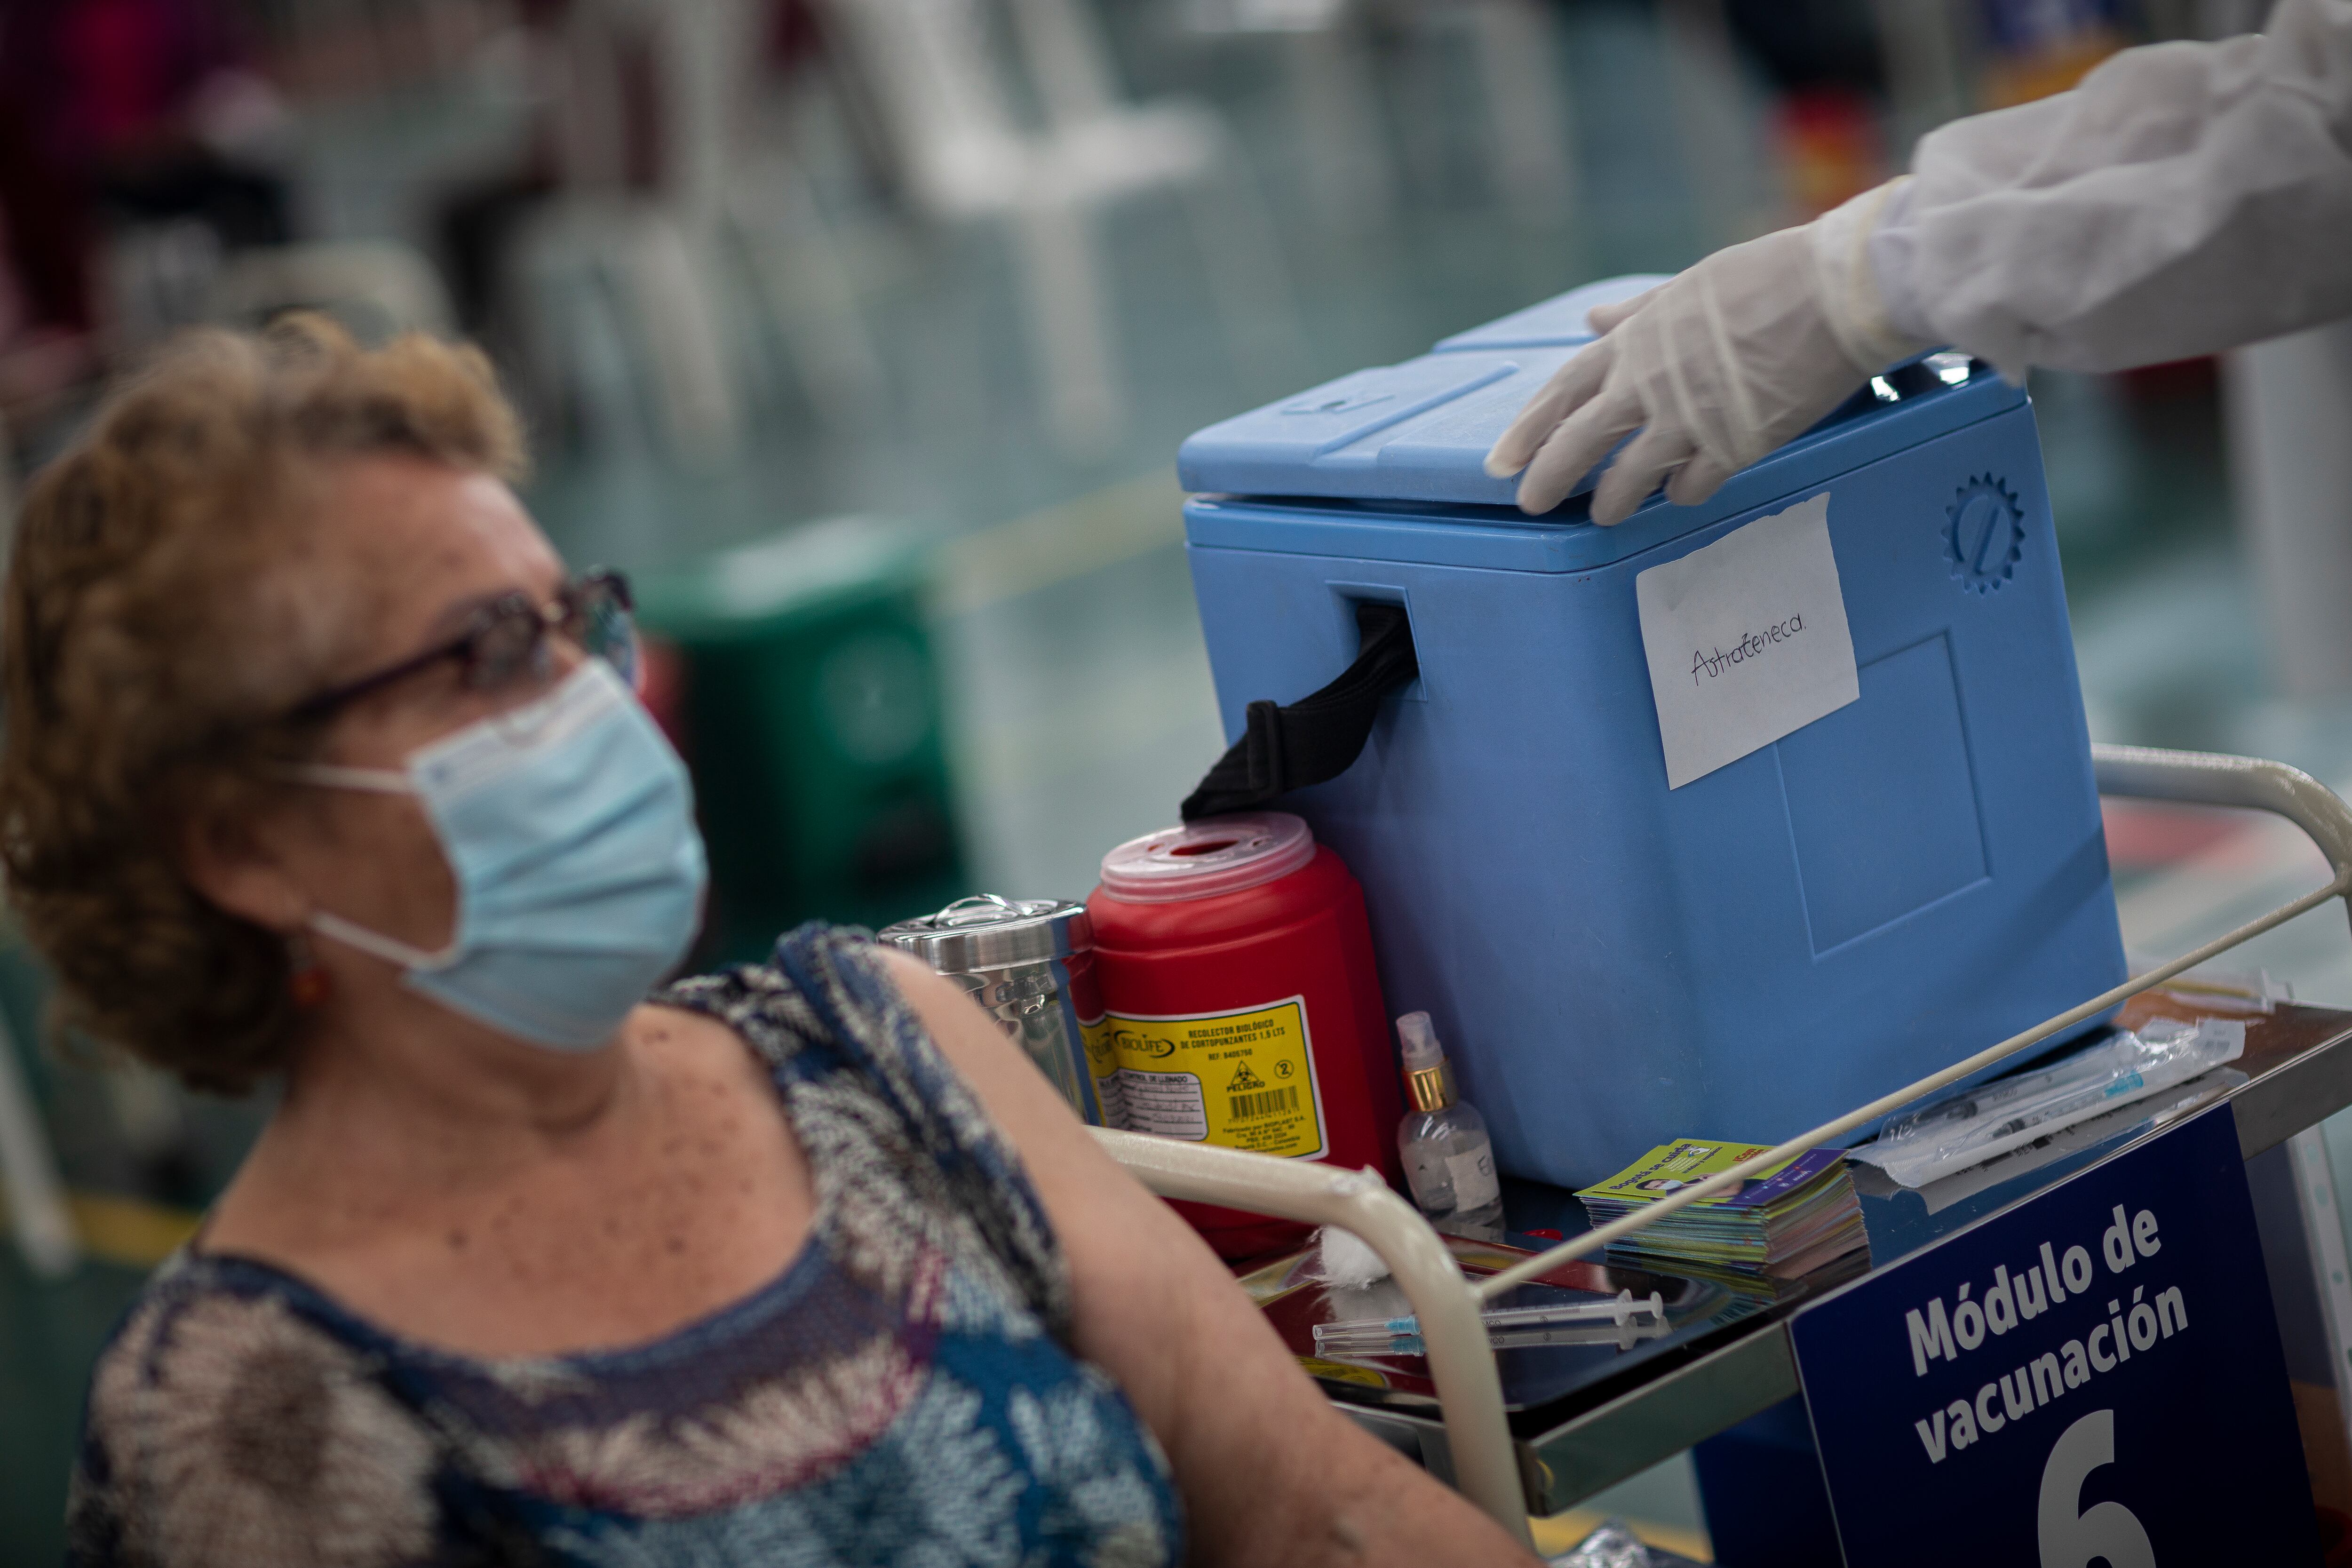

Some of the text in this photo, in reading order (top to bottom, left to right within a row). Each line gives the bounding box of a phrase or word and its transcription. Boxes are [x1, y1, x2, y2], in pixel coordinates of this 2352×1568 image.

[1180, 1041, 1190, 1049] DE
[1192, 1033, 1257, 1049] CORTOPUNZANTES
[1272, 1027, 1286, 1037] LTS
[1188, 1019, 1274, 1038] RECOLECTOR BIOLÓGICO
[1280, 1062, 1289, 1075] 2
[1226, 1081, 1265, 1092] PELIGRO
[1608, 1170, 1653, 1189] Bogotá
[1661, 1143, 1692, 1163] cuida
[1905, 1203, 2161, 1377] Módulo de
[1915, 1285, 2188, 1464] vacunación
[2038, 1409, 2157, 1568] 6
